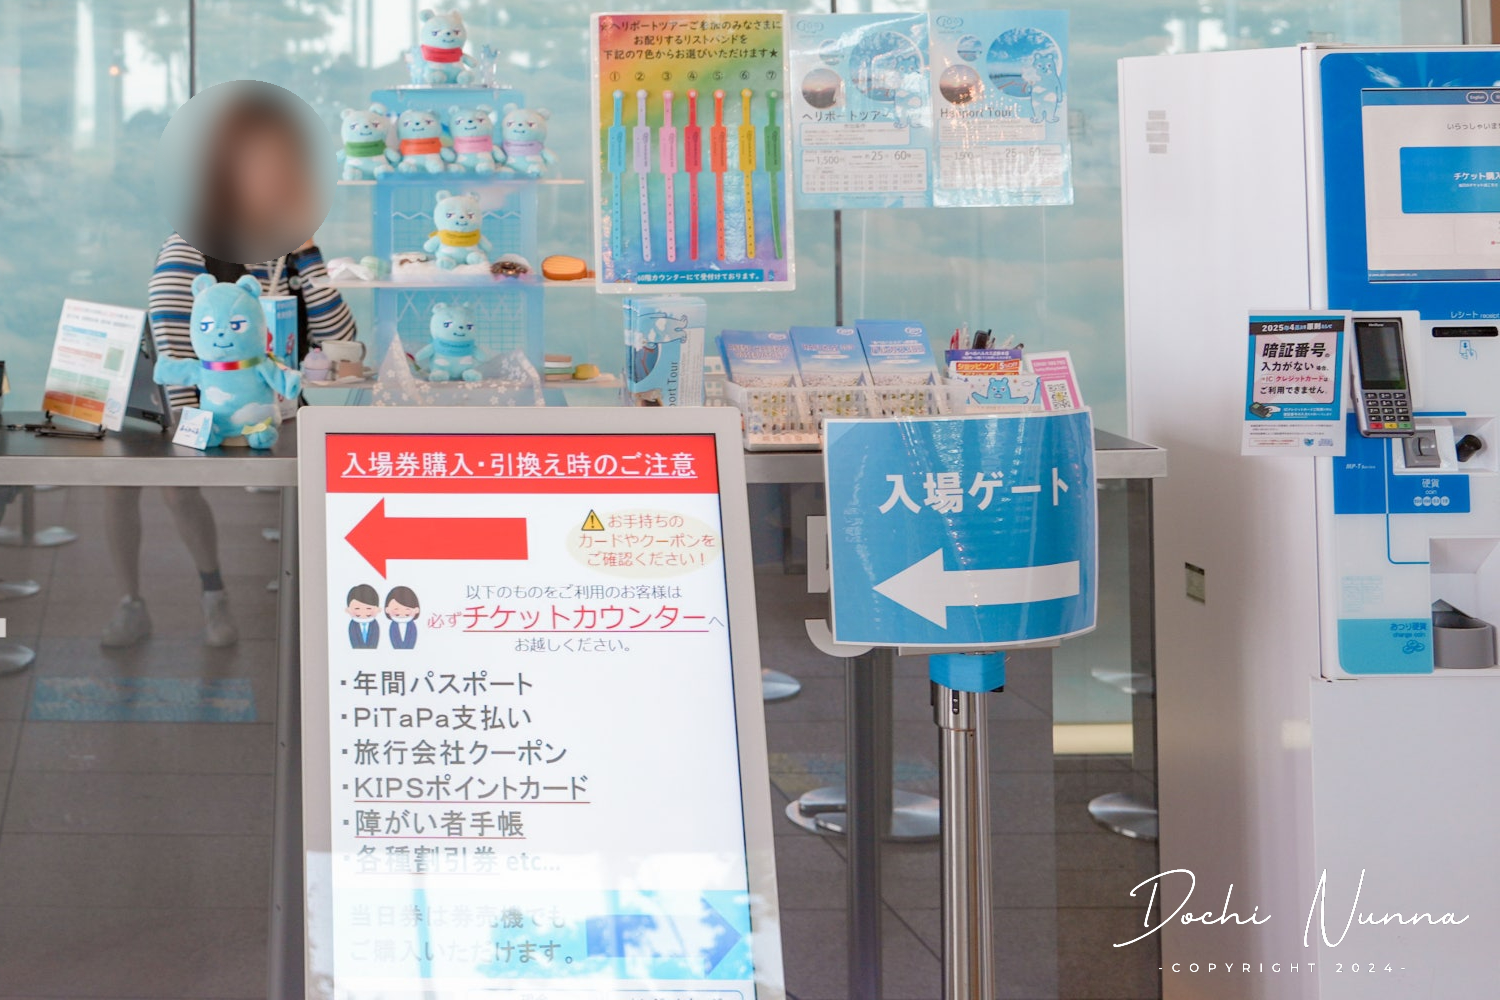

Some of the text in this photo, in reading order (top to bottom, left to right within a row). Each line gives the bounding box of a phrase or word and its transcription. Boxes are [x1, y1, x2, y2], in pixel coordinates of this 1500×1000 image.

[634, 35, 748, 45] お配りするリストバンドを
[609, 72, 620, 82] ①
[635, 72, 645, 82] ②
[687, 72, 698, 82] ④
[766, 70, 777, 81] ⑦
[988, 106, 1013, 118] Tour
[1262, 343, 1330, 358] 暗証番号の
[1260, 386, 1328, 395] ご利用できません。
[341, 451, 696, 478] 入場券購入・引換え時のご注意
[878, 467, 1069, 515] 入場ゲート
[608, 513, 684, 529] お手持ちの
[579, 532, 716, 549] カードやクーポンを
[466, 584, 683, 600] 以下のものをご利用のお客様は
[427, 604, 725, 630] 必ずチケットカウンターへ
[514, 637, 633, 654] お越しください。
